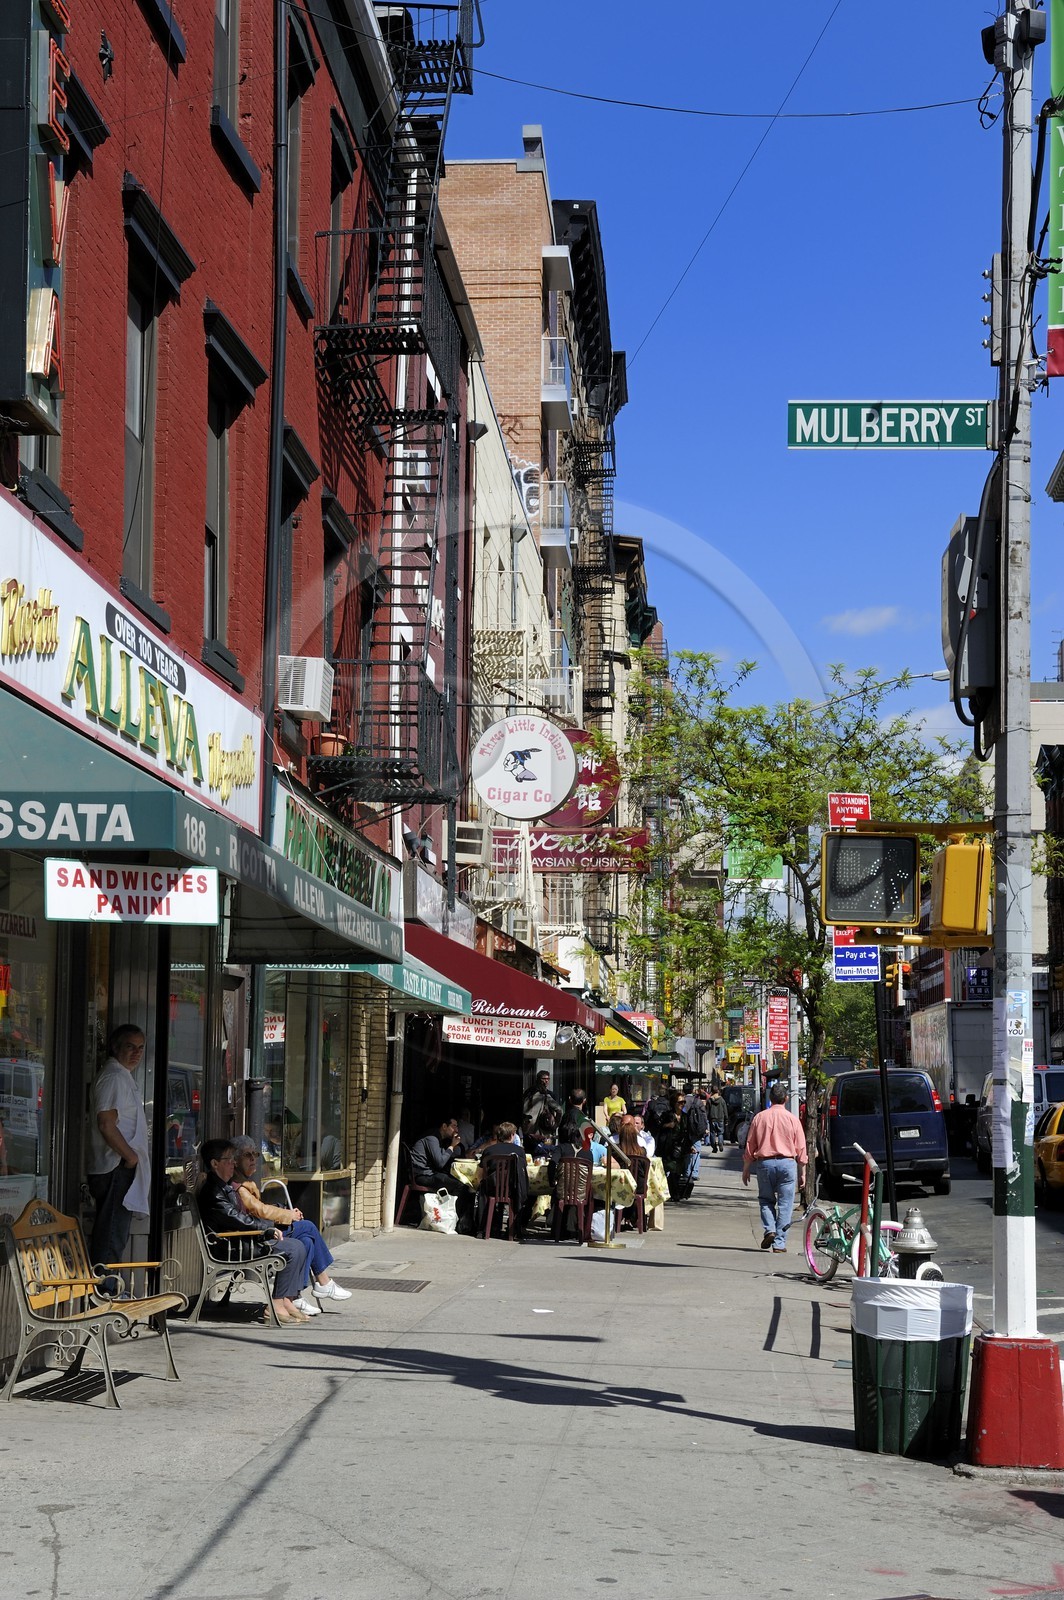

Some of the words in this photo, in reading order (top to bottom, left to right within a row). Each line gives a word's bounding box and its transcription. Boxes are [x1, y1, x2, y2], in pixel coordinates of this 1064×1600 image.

[796, 408, 959, 443] MULBERRY
[965, 407, 984, 426] ST
[114, 613, 137, 652] OVER
[138, 634, 152, 664] 100
[154, 646, 179, 687] YEARS
[61, 615, 204, 782] ALLEVA
[478, 729, 505, 758] Three
[504, 719, 536, 735] Little
[539, 722, 567, 762] Indians
[487, 787, 529, 803] Cigar
[533, 789, 556, 803] Co.
[841, 797, 867, 806] STANDING
[836, 806, 864, 815] ANYTIME
[502, 857, 575, 868] MAAYSIAN
[581, 857, 630, 868] CUISINE
[56, 867, 208, 894] SANDWICHES
[184, 812, 207, 858] 188
[229, 834, 278, 893] RICOTTA
[294, 875, 326, 921] ALLEVA
[337, 902, 382, 950] MOZZARELLA
[97, 893, 171, 916] PANINI
[845, 951, 858, 961] Pay
[859, 951, 867, 959] at
[836, 967, 877, 975] Muni-Meter
[471, 999, 551, 1018] Ristorante
[462, 1017, 494, 1027] LUNCH
[498, 1020, 536, 1030] SPECIAL
[447, 1024, 470, 1033] PASTA
[474, 1026, 494, 1035] WITH
[497, 1028, 522, 1037] SALAD
[527, 1030, 547, 1039] 10.95
[1008, 1028, 1024, 1036] YOU
[447, 1033, 472, 1041] STONE
[475, 1035, 496, 1043] OVEN
[526, 1039, 551, 1047] $10.95
